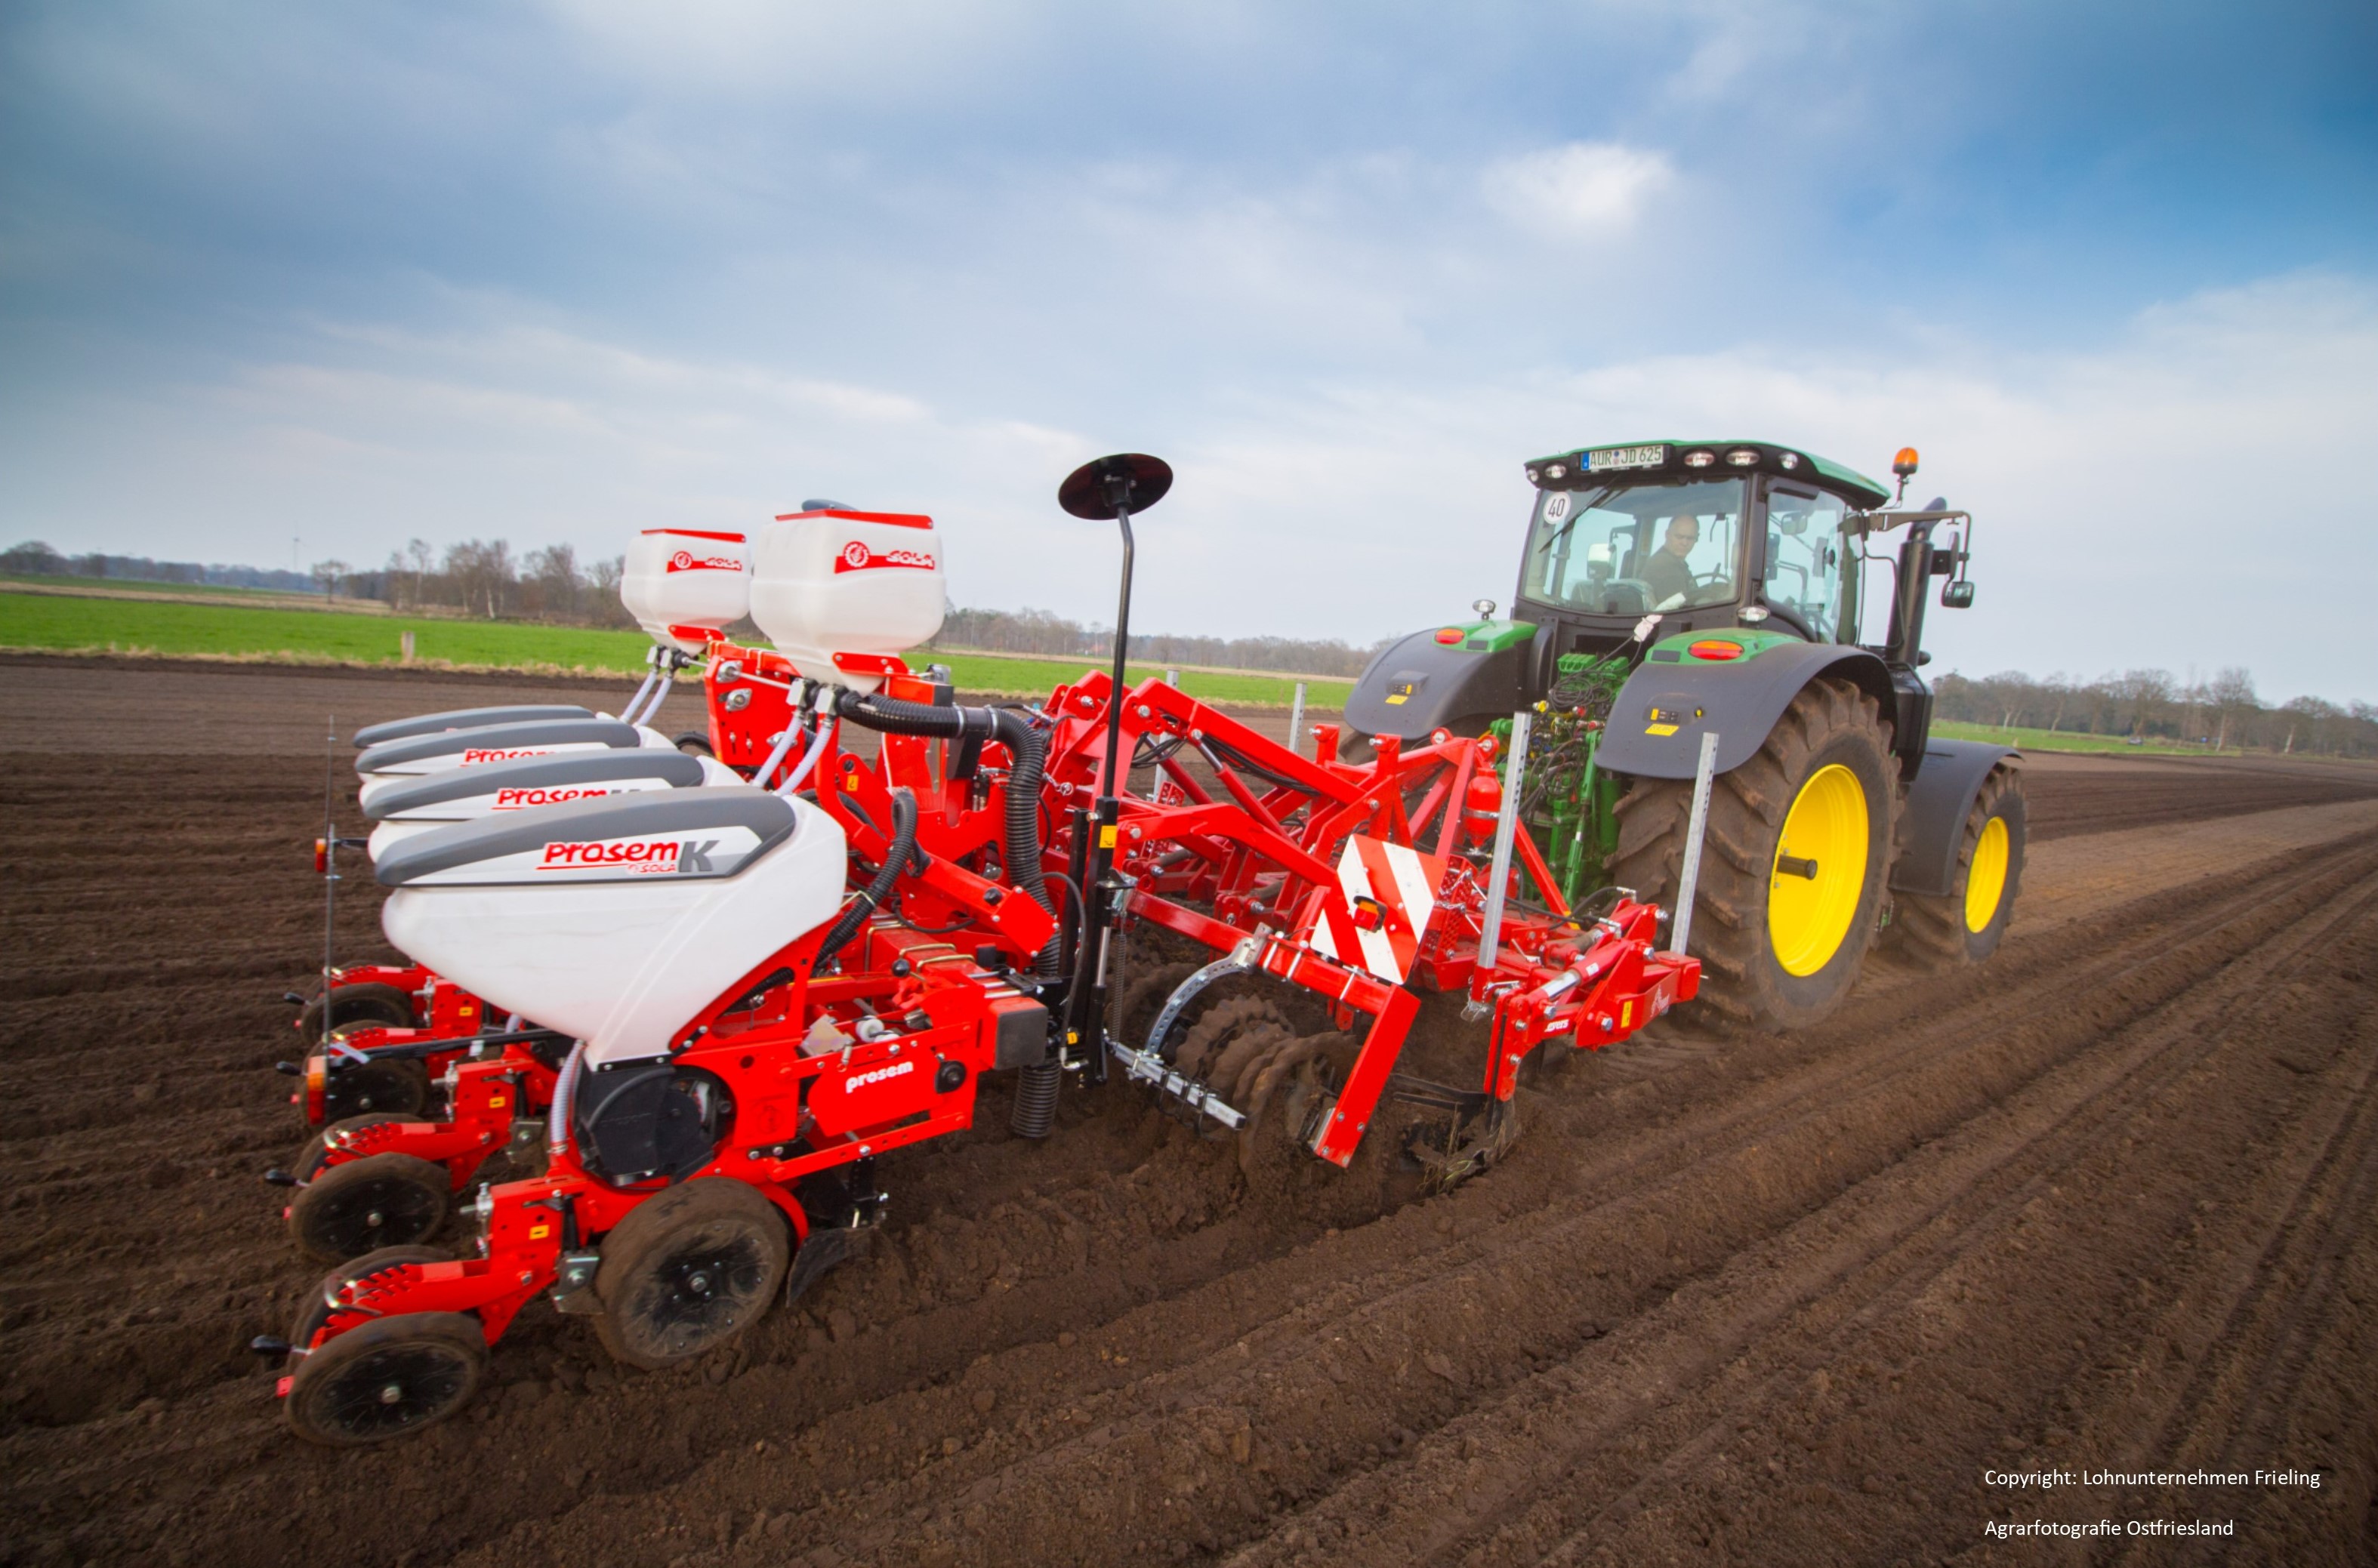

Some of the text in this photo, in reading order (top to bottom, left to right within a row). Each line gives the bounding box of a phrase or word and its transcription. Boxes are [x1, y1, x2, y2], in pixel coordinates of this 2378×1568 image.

[1590, 446, 1661, 467] AUR JD 625
[1548, 498, 1565, 517] 40
[886, 550, 935, 568] SOLA
[679, 840, 720, 873] K
[638, 864, 677, 873] SOLA
[846, 1061, 914, 1094] prosem
